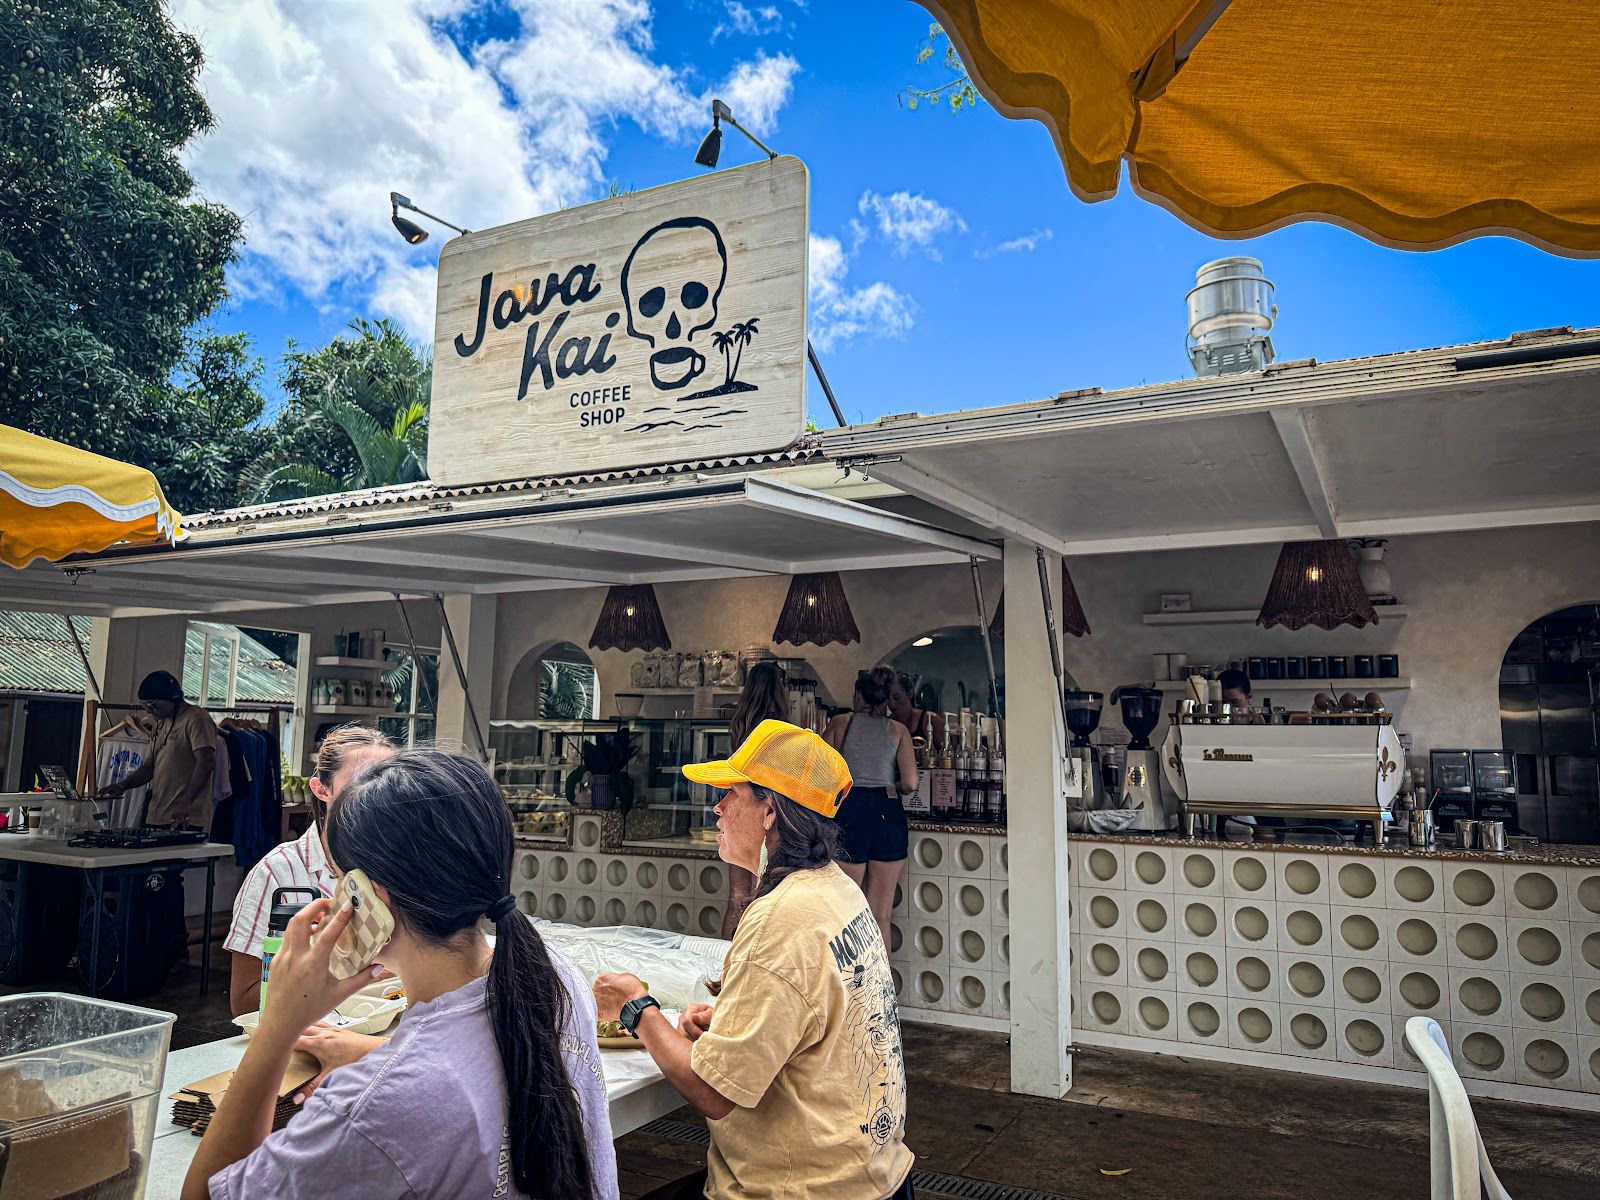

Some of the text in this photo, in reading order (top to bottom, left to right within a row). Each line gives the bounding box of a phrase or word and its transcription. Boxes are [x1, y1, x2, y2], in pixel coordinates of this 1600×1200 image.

[454, 263, 601, 358] Java
[518, 311, 620, 401] Kai
[570, 385, 631, 408] COFFEE
[580, 407, 625, 427] SHOP
[860, 1123, 869, 1135] W
